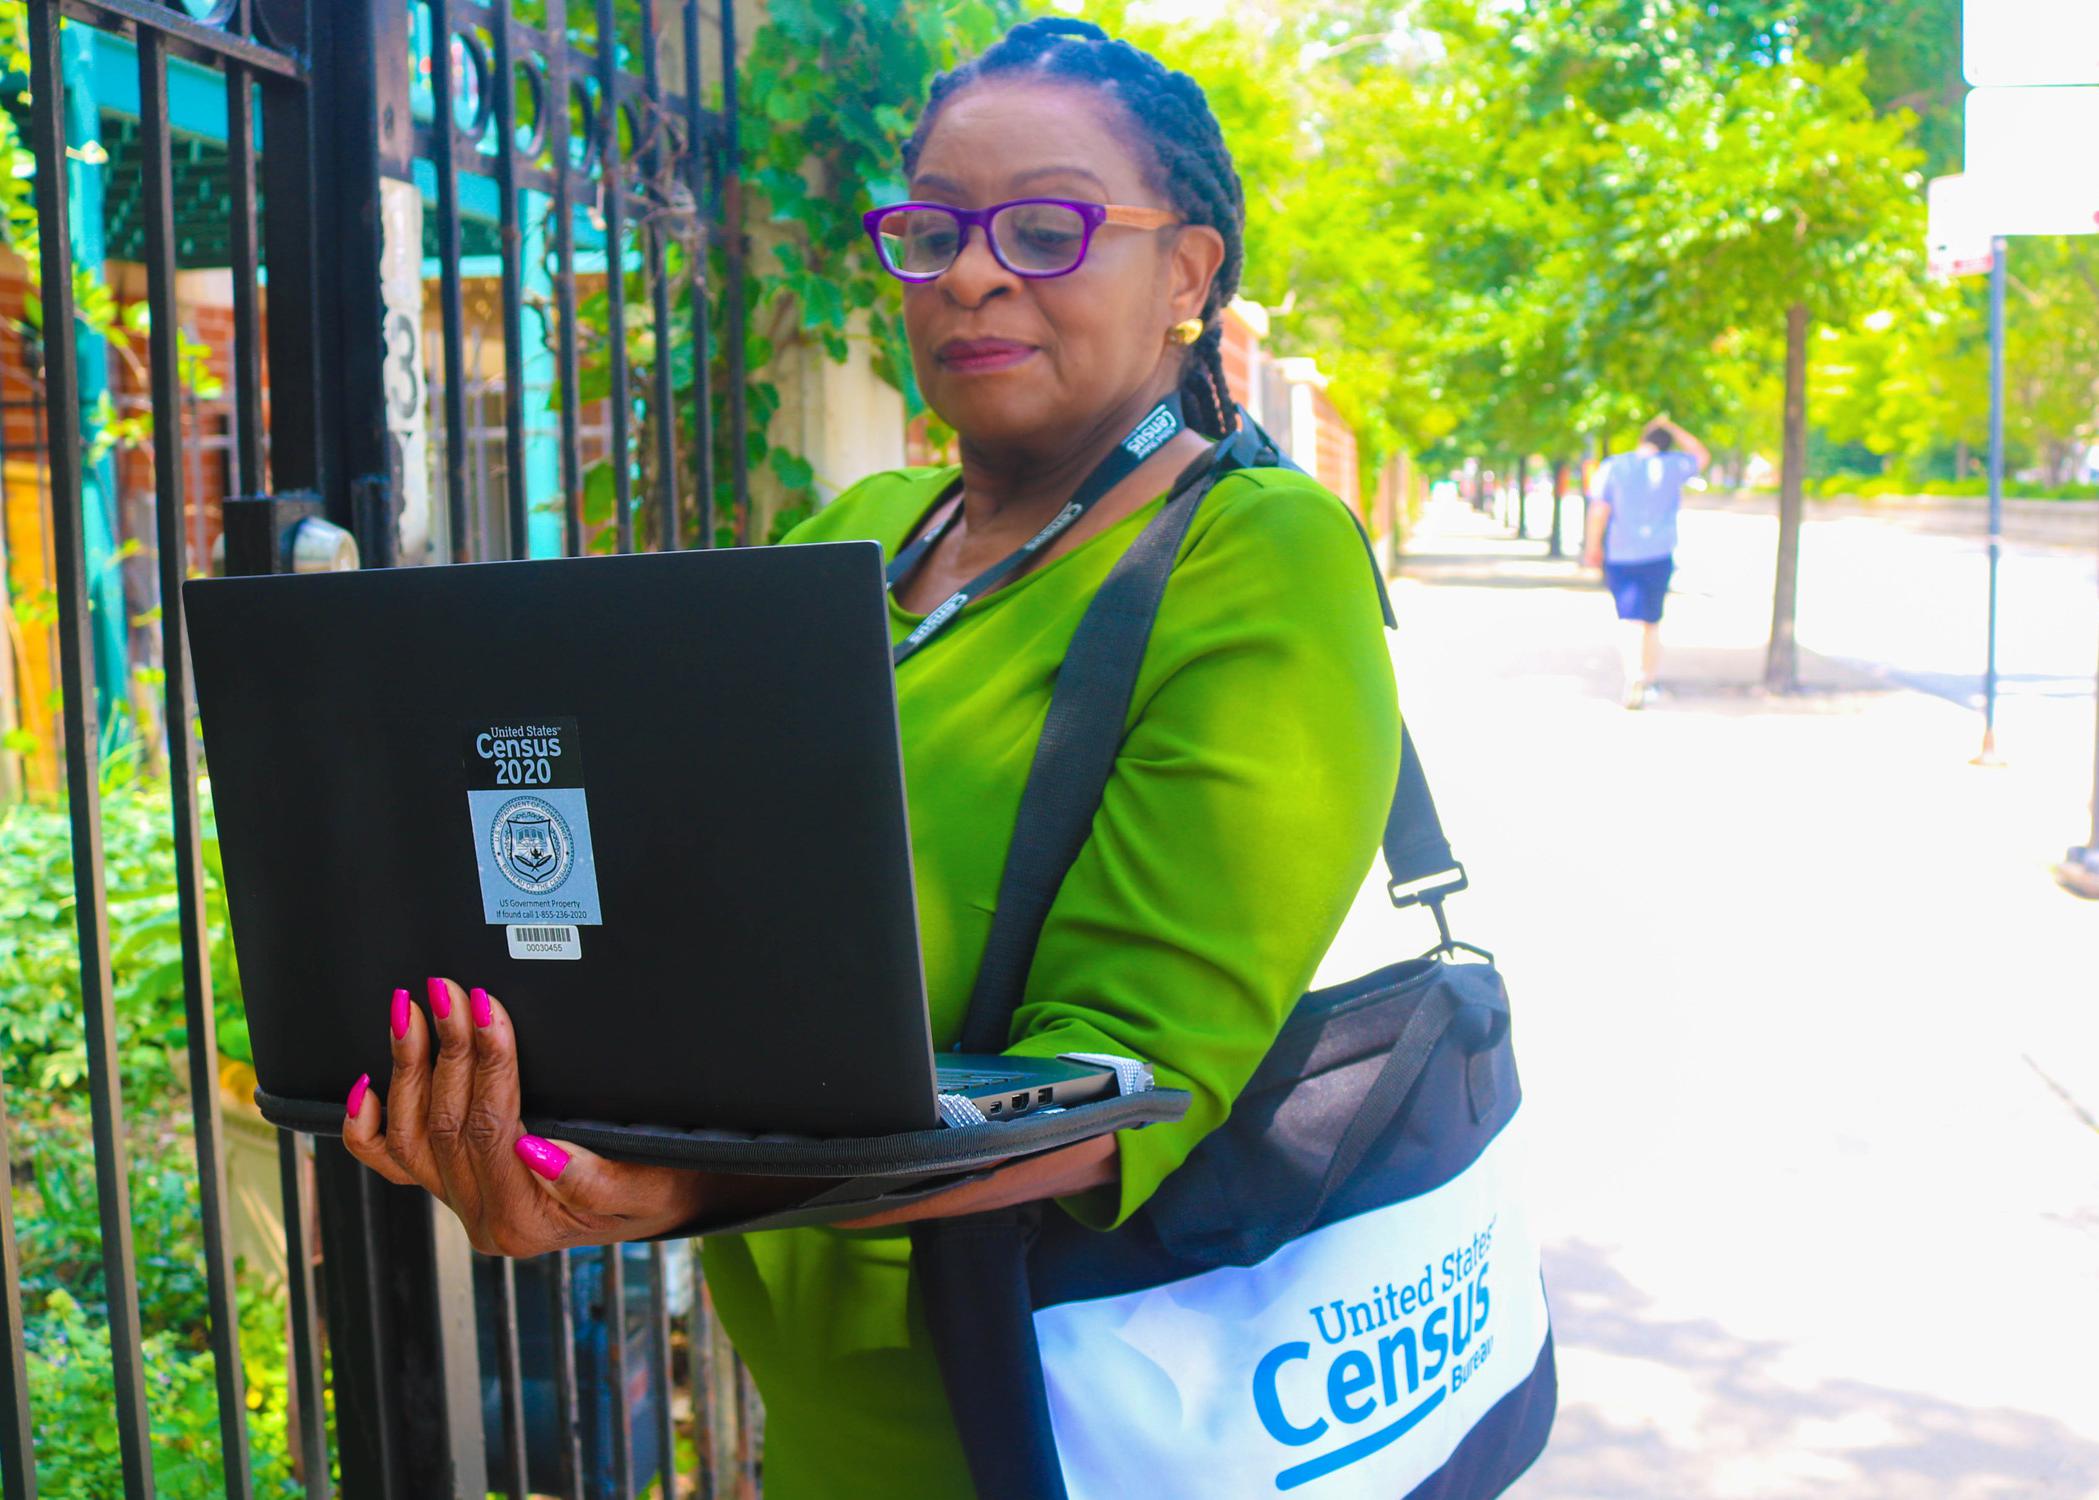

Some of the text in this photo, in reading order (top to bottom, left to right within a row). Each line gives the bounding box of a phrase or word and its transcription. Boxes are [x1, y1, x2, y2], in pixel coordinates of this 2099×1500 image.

[391, 314, 417, 419] 3
[1126, 410, 1176, 453] Census
[908, 592, 968, 644] Census
[476, 733, 561, 758] Census
[491, 726, 524, 738] United
[495, 758, 551, 784] 2020
[497, 801, 530, 828] DEPARTMENT
[541, 805, 568, 840] COMMERCE
[502, 863, 524, 887] BUREAU
[549, 863, 569, 886] CENSUS
[551, 900, 580, 908] Property
[1309, 1264, 1434, 1344] United
[1253, 1262, 1489, 1446] Census
